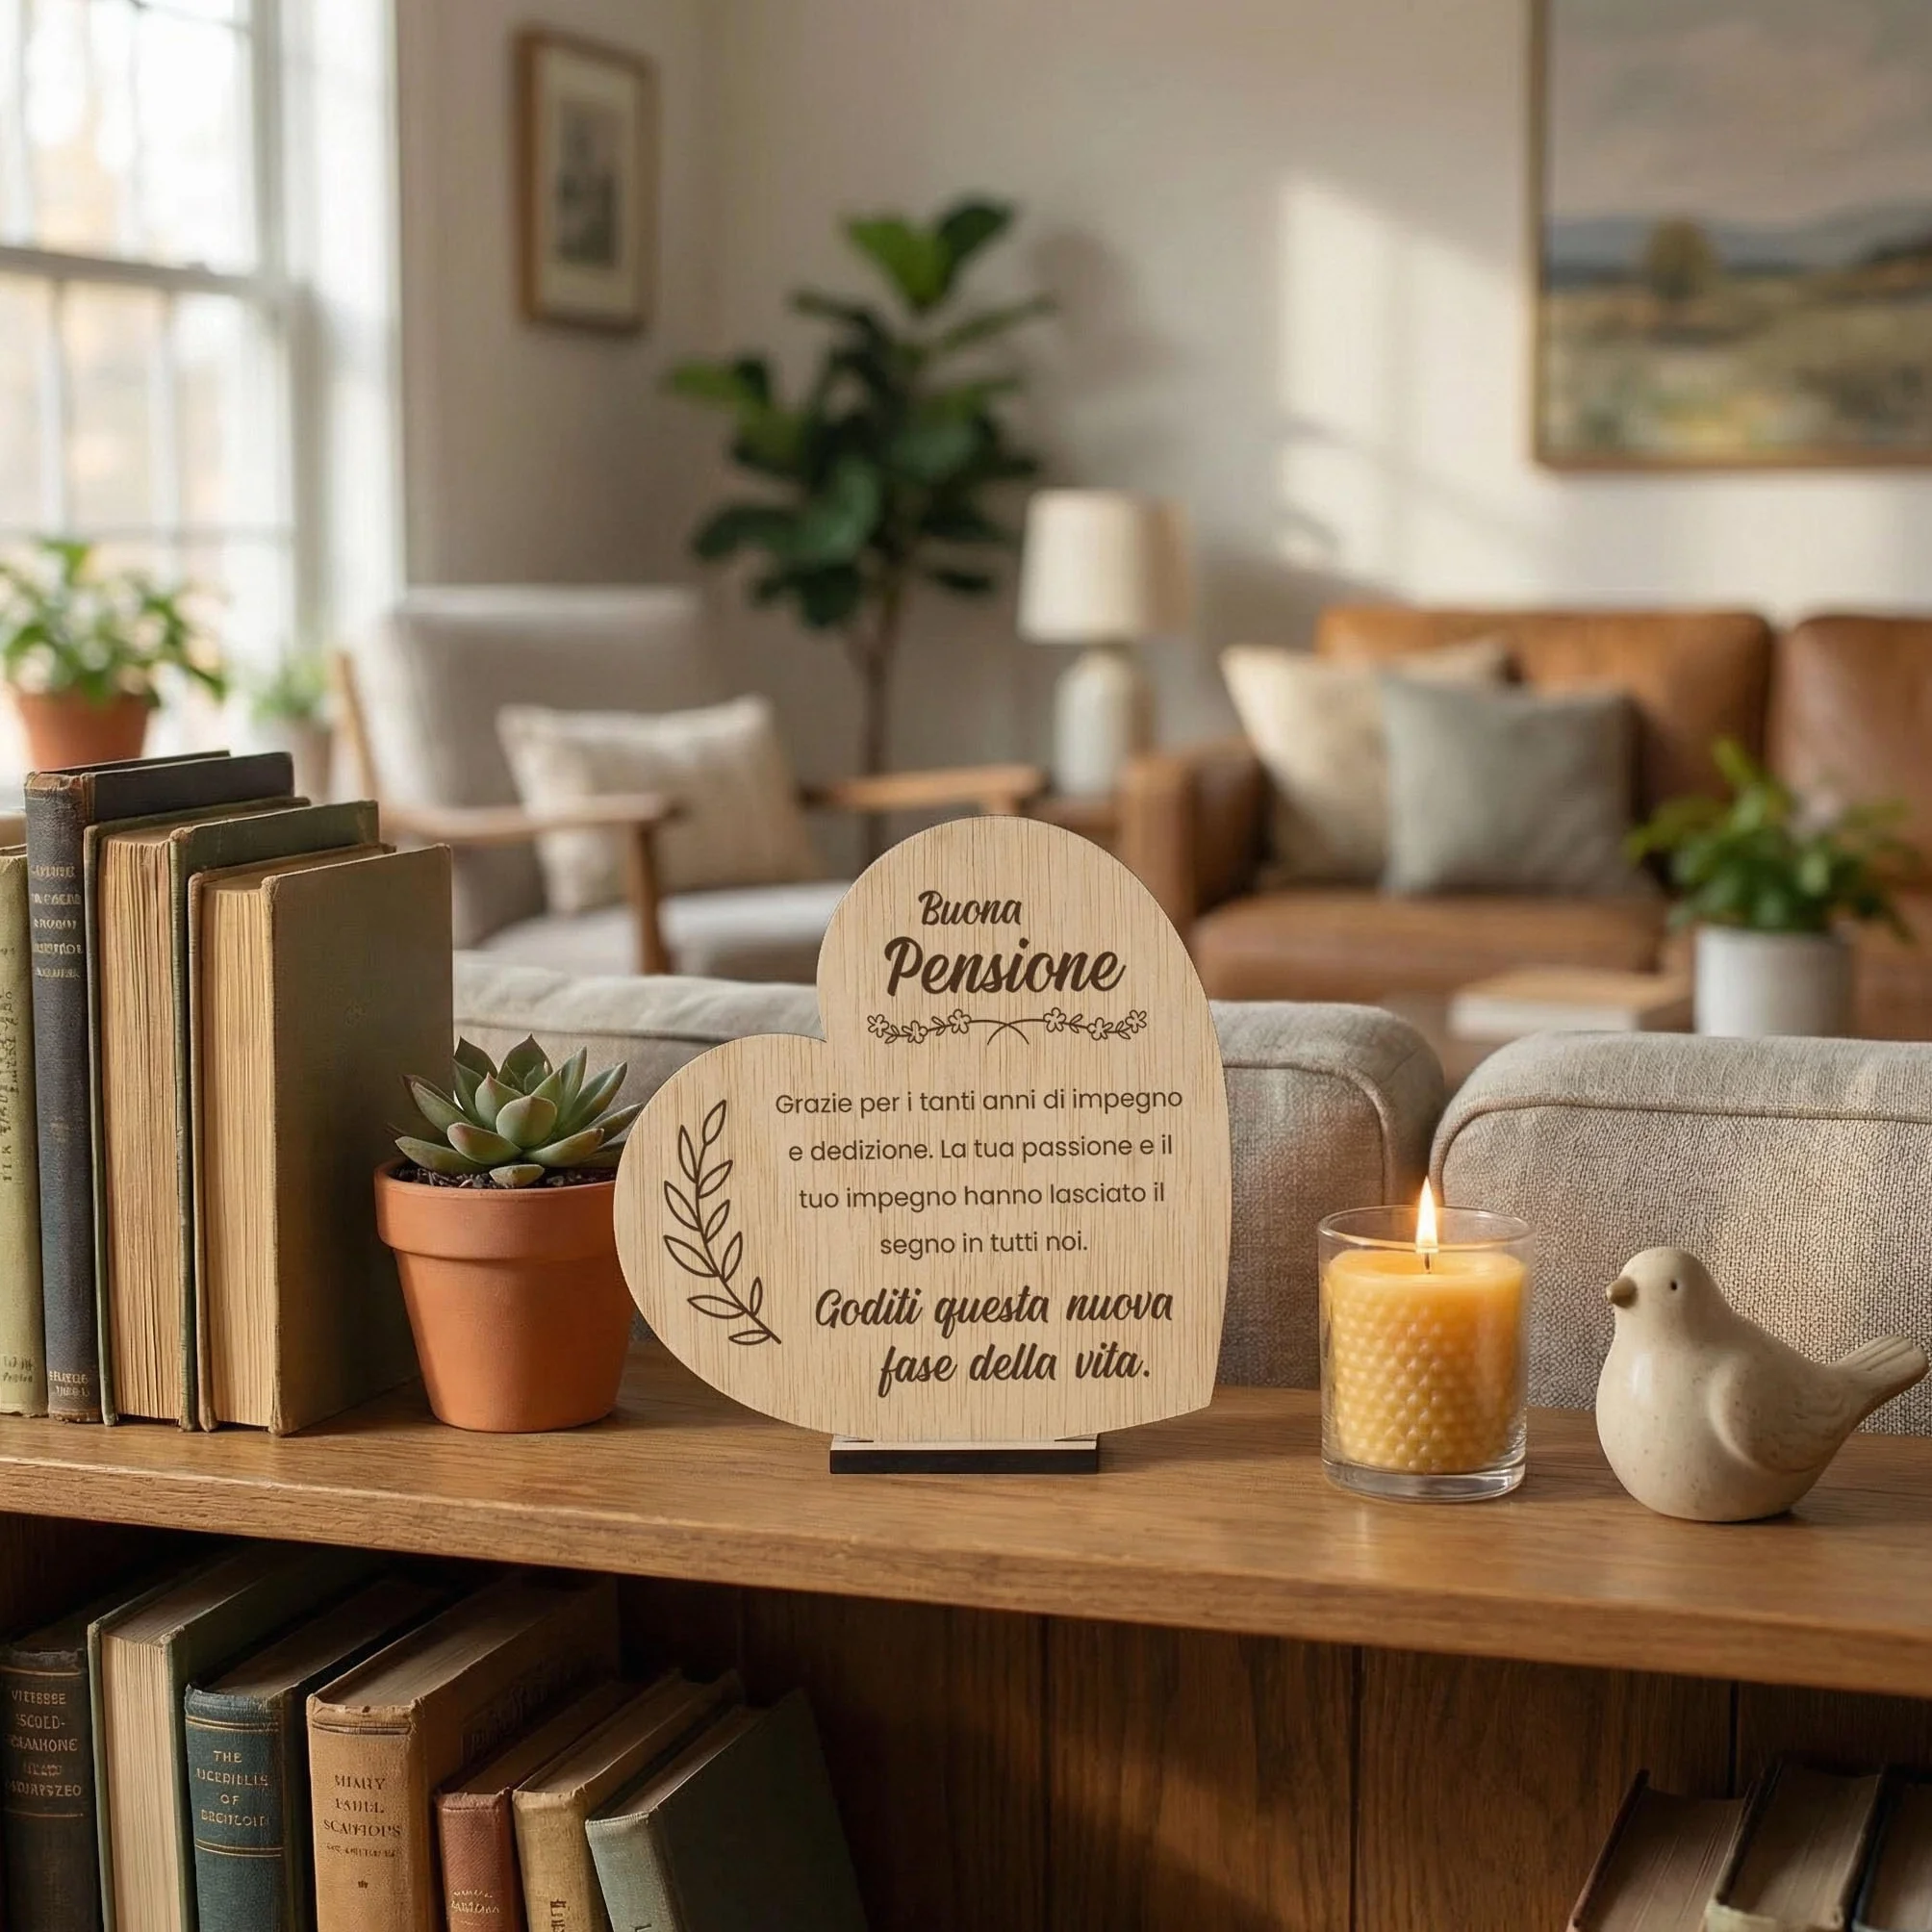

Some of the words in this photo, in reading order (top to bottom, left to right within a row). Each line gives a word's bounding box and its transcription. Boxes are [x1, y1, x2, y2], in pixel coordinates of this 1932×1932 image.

[918, 889, 1023, 927] Buona
[883, 936, 1127, 998] Pensione
[775, 1093, 852, 1115] Grazie
[860, 1095, 901, 1120] per
[906, 1092, 913, 1113] i
[919, 1091, 976, 1112] tanti
[982, 1090, 1035, 1111] anni
[1043, 1088, 1066, 1110] di
[1072, 1087, 1183, 1116] impegno
[788, 1145, 803, 1161] e
[810, 1138, 933, 1162] dedizione.
[940, 1138, 968, 1159] La
[973, 1138, 1015, 1159] tua
[1022, 1135, 1133, 1165] passione
[1139, 1139, 1155, 1157] e
[1160, 1132, 1173, 1156] il
[799, 1188, 839, 1209] tuo
[846, 1187, 956, 1215] impegno
[963, 1184, 1043, 1207] hanno
[1049, 1182, 1147, 1206] lasciato
[1153, 1181, 1165, 1203] il
[879, 1237, 955, 1262] segno
[961, 1233, 984, 1254] in
[990, 1232, 1039, 1254] tutti
[1045, 1230, 1088, 1253] noi.
[815, 1286, 924, 1330] Goditi
[933, 1284, 1050, 1339] questa
[1065, 1289, 1174, 1322] nuova
[877, 1345, 957, 1400] fase
[969, 1341, 1057, 1383] della
[1075, 1339, 1151, 1381] vita.
[213, 1750, 243, 1764] THE
[219, 1794, 240, 1806] OF
